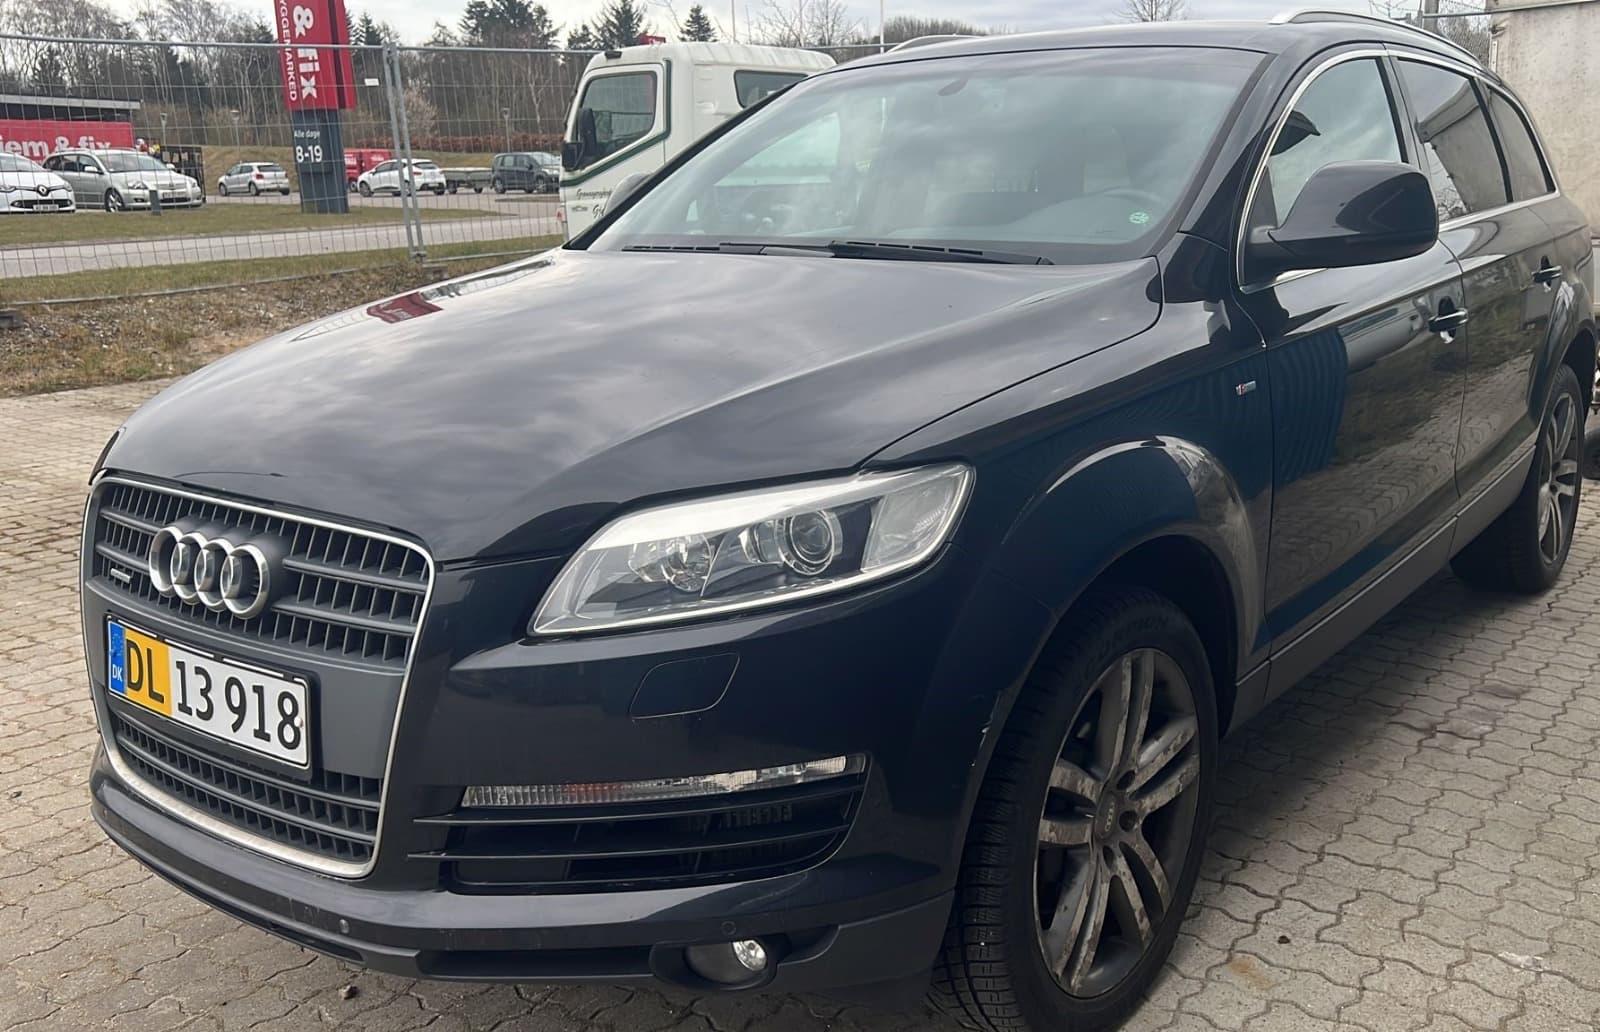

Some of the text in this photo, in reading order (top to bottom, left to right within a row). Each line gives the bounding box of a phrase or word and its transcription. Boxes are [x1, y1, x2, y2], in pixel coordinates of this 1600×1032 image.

[293, 5, 320, 100] & fix
[296, 145, 323, 163] 8-19
[112, 663, 123, 682] DK
[126, 638, 302, 750] DL 13 918
